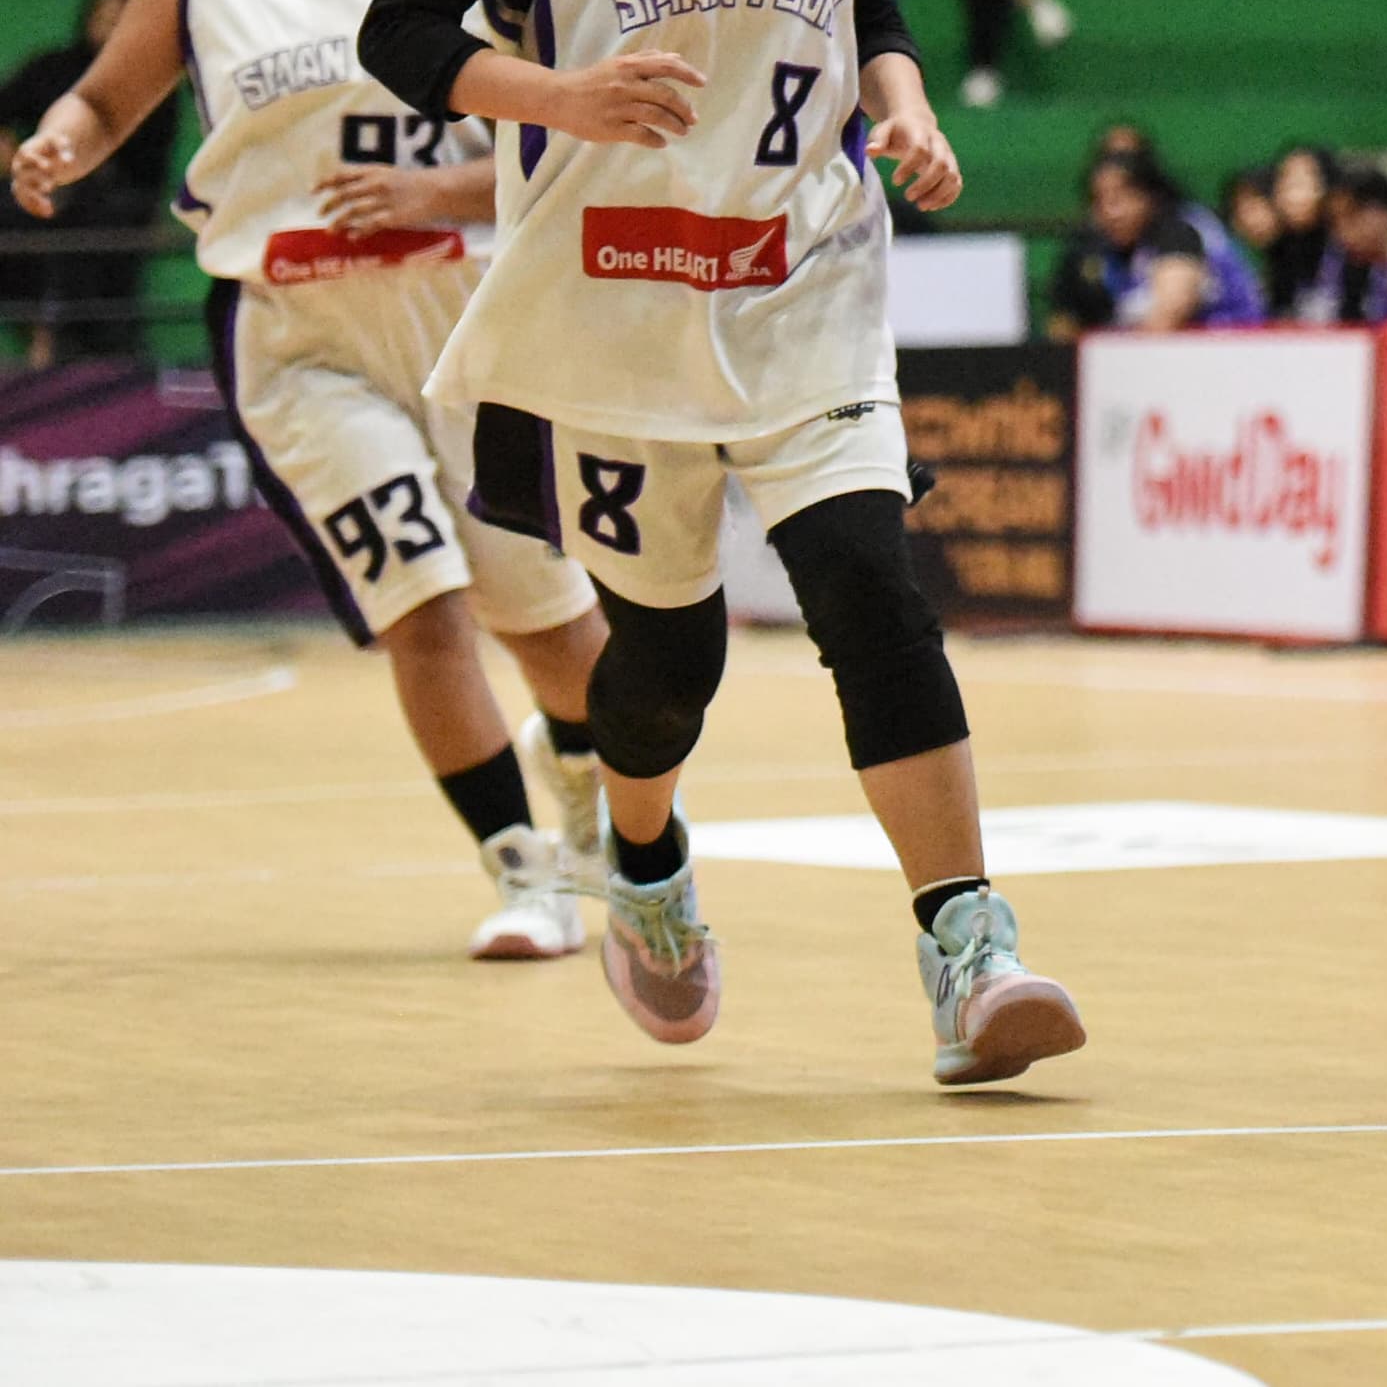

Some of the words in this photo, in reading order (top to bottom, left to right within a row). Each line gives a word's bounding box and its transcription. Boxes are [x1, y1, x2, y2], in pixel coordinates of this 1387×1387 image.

[232, 35, 349, 111] SMAN
[753, 61, 823, 166] 8
[597, 245, 648, 270] One
[324, 473, 444, 583] 93
[577, 452, 646, 556] 8
